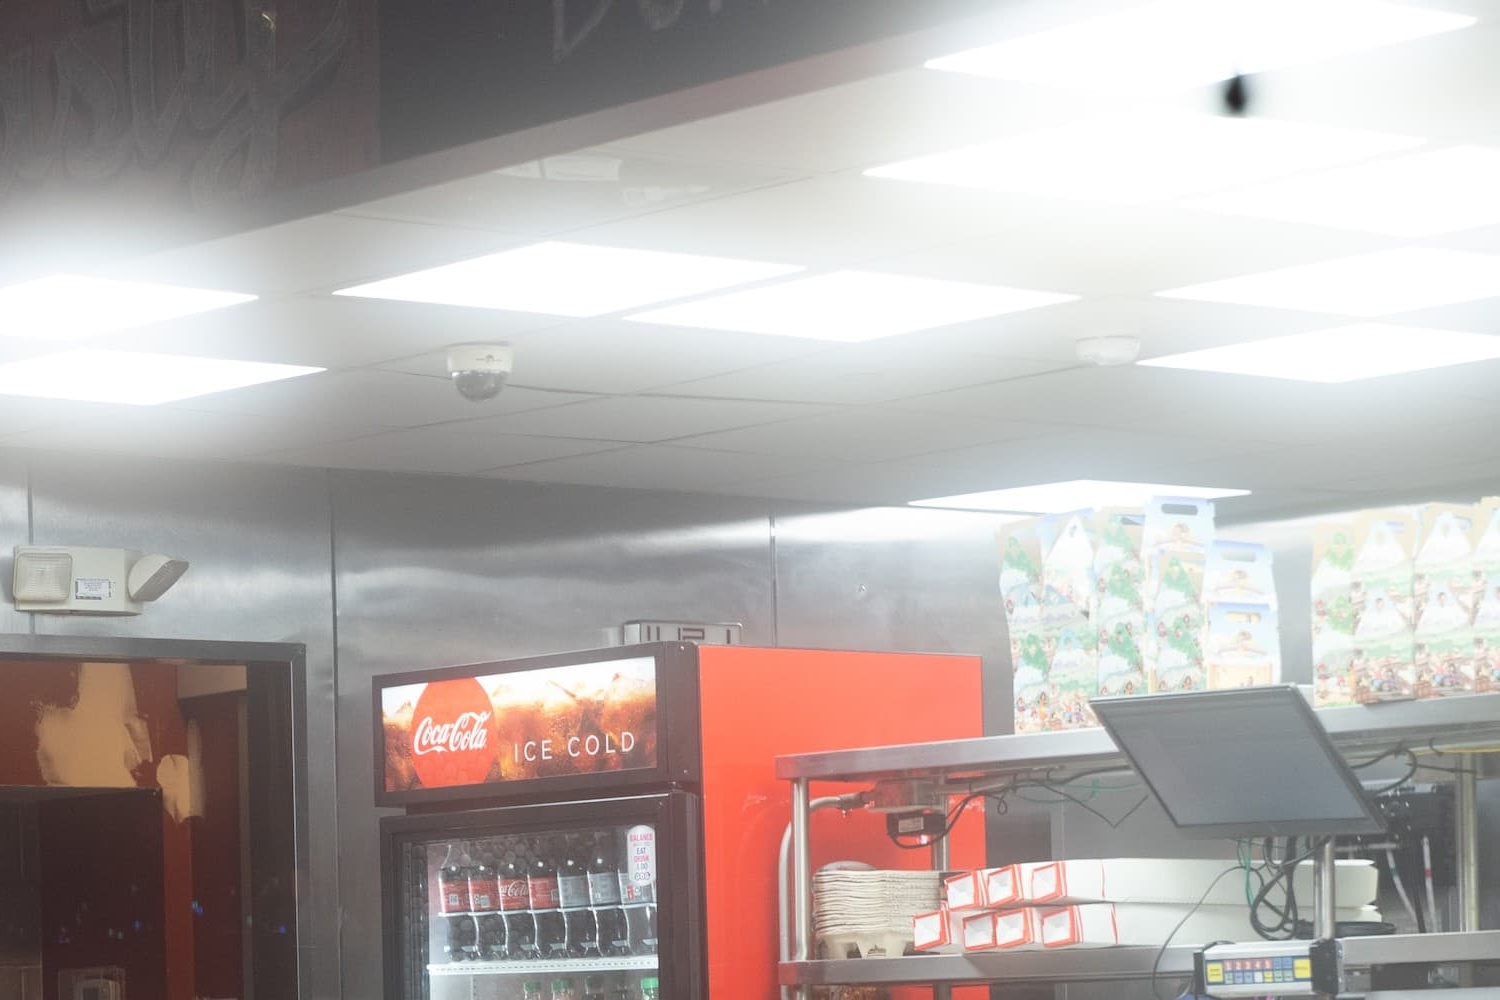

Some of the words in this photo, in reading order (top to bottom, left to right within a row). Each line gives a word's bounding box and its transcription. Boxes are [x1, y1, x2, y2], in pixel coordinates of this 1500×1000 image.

[413, 711, 491, 756] Coca-Cola
[514, 739, 553, 762] ICE
[567, 731, 635, 757] COLD
[636, 847, 646, 855] EAT
[1226, 961, 1232, 971] 1
[1235, 961, 1242, 970] 2
